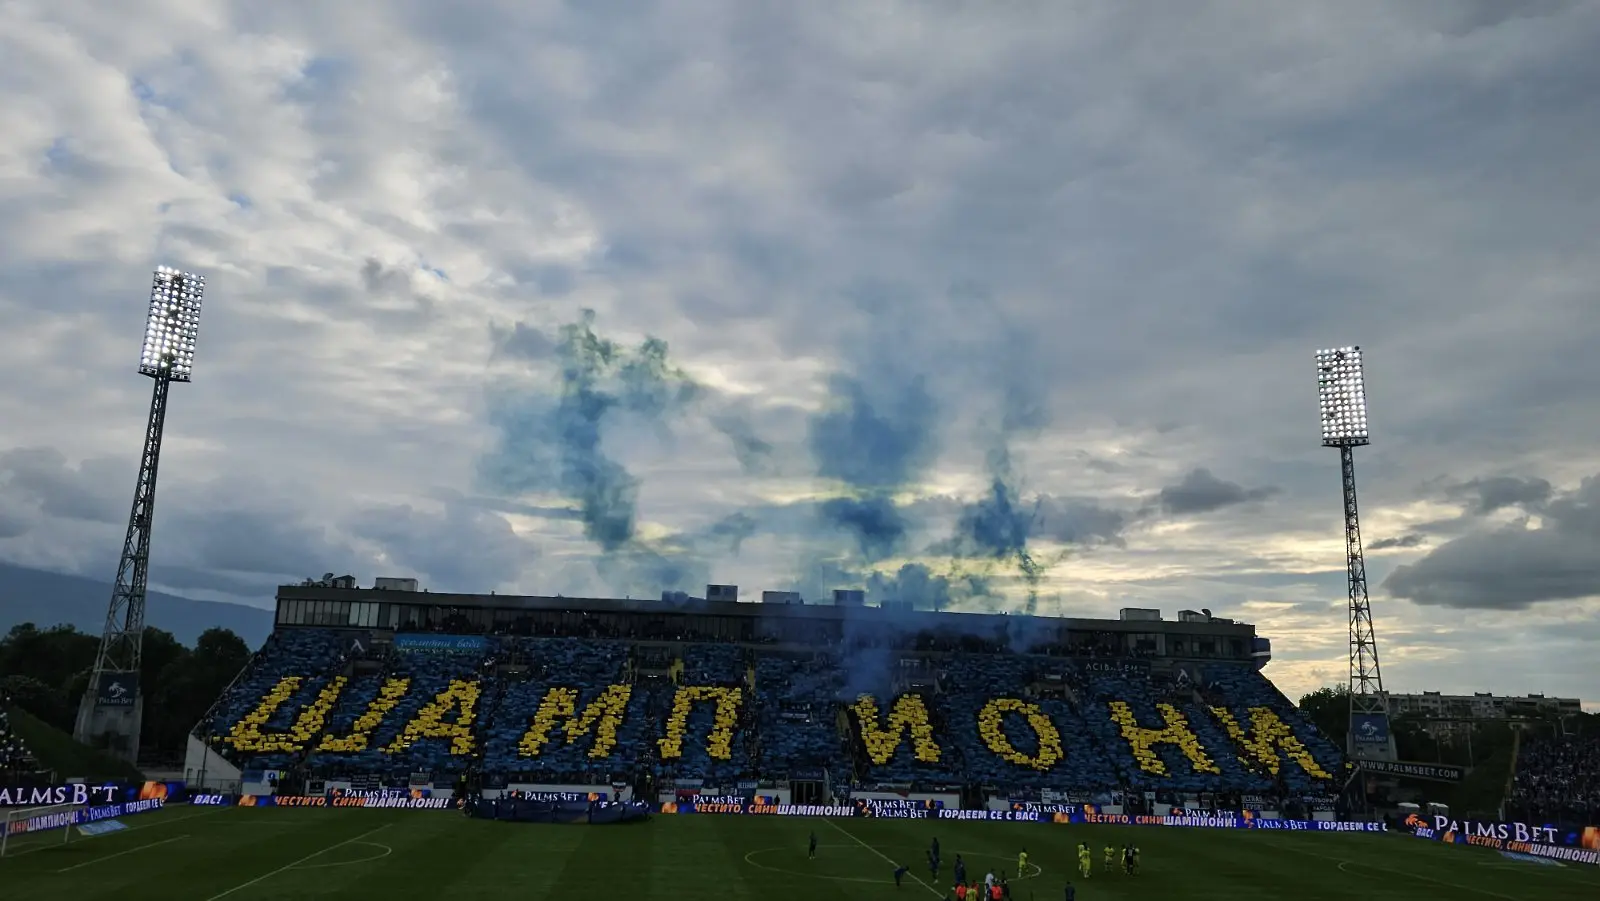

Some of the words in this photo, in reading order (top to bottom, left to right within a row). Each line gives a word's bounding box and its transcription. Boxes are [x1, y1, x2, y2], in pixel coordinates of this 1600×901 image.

[1359, 760, 1459, 780] WWW.PALMSBET.COM
[193, 794, 223, 805] ВАС!
[344, 788, 379, 799] PALMS
[380, 788, 402, 799] BET
[525, 790, 559, 802] PALMS
[125, 798, 151, 813] ГОРДЕЕМ
[274, 795, 328, 808] ЧЕСТИТО,
[726, 795, 746, 805] BET
[866, 798, 898, 809] PALMS
[899, 800, 919, 810] BET
[90, 806, 111, 820] PALMS
[109, 804, 121, 818] BET
[695, 803, 744, 815] ЧЕСТИТО,
[874, 807, 908, 819] PALMS
[909, 809, 929, 819] BET
[938, 808, 987, 820] ГОРДЕЕМ
[990, 810, 1003, 820] СЕ
[1005, 810, 1013, 820] С
[1015, 810, 1039, 821] ВАС!
[1057, 804, 1076, 814] BET
[1084, 813, 1132, 825] ЧЕСТИТО,
[1289, 818, 1310, 831] BET
[1317, 820, 1366, 832] ГОРДЕЕМ
[1367, 822, 1380, 832] СЕ
[1433, 815, 1509, 841] PALMS
[1415, 827, 1435, 839] ВАС!
[1465, 834, 1504, 850] ЧЕСТИТО,
